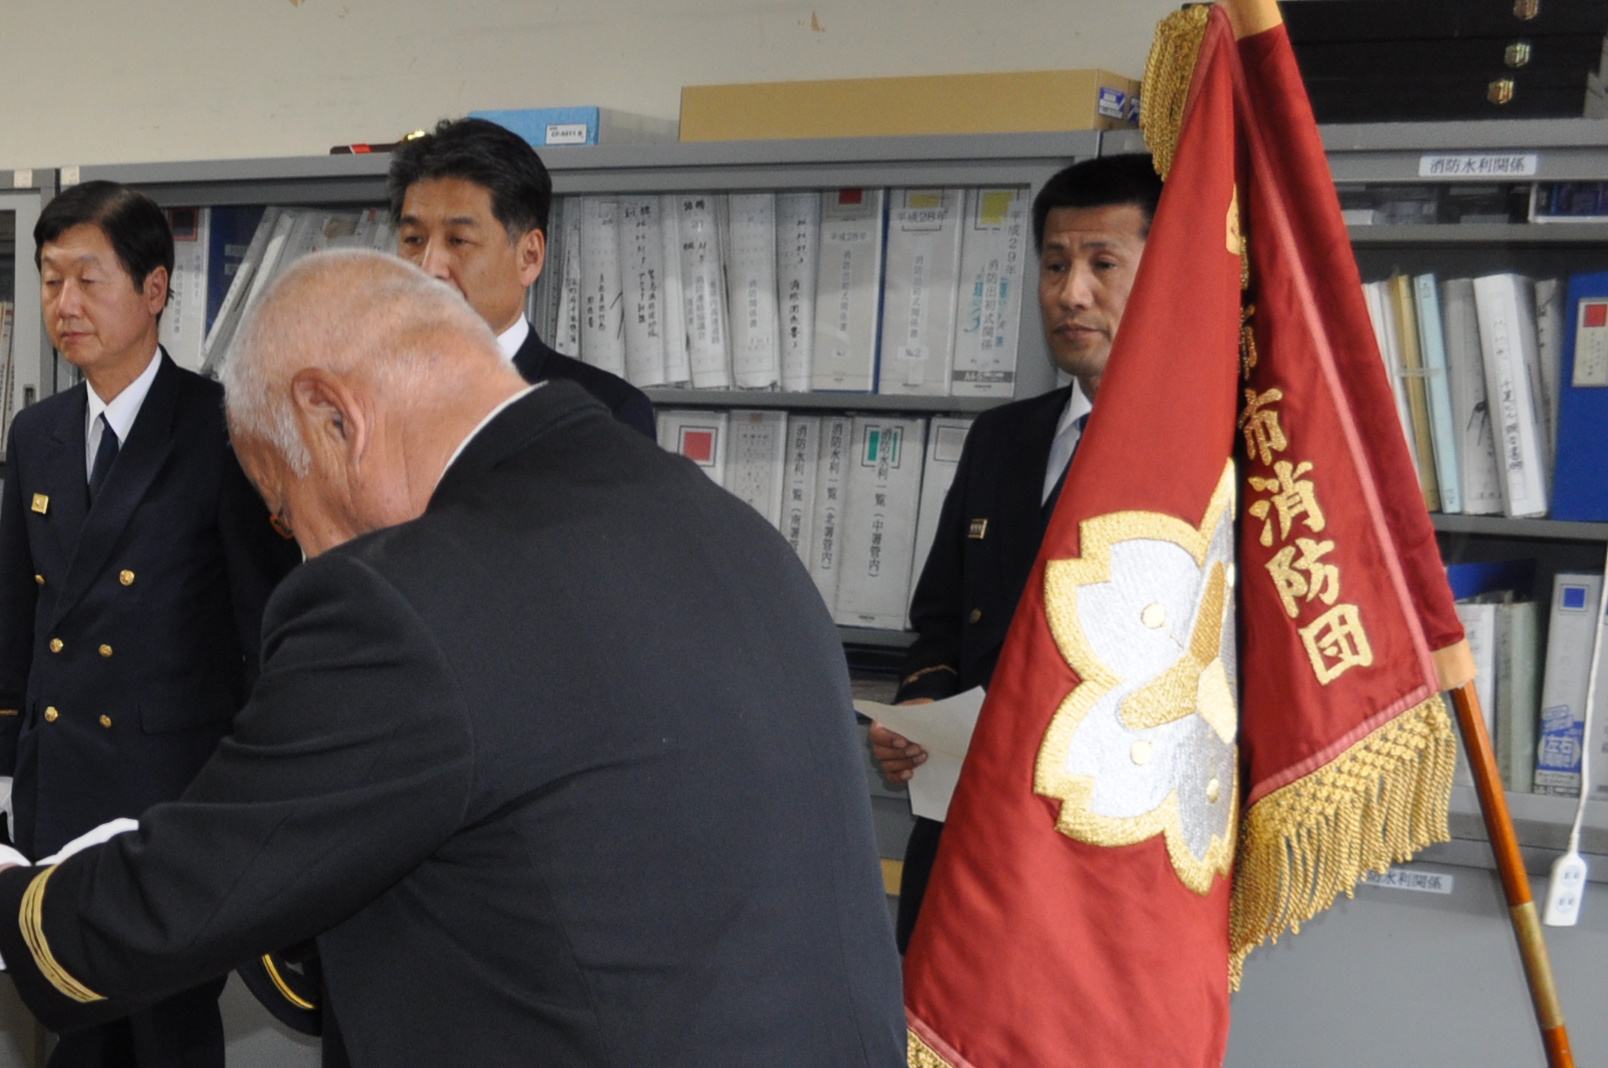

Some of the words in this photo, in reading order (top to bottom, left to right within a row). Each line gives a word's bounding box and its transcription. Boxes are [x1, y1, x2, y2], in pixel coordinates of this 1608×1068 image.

[1430, 157, 1525, 173] 消防水利関係
[897, 210, 949, 223] 平成28年
[1005, 209, 1021, 275] 平成29年
[981, 259, 1000, 351] 消防出初式関係
[1237, 236, 1376, 688] 市消防団
